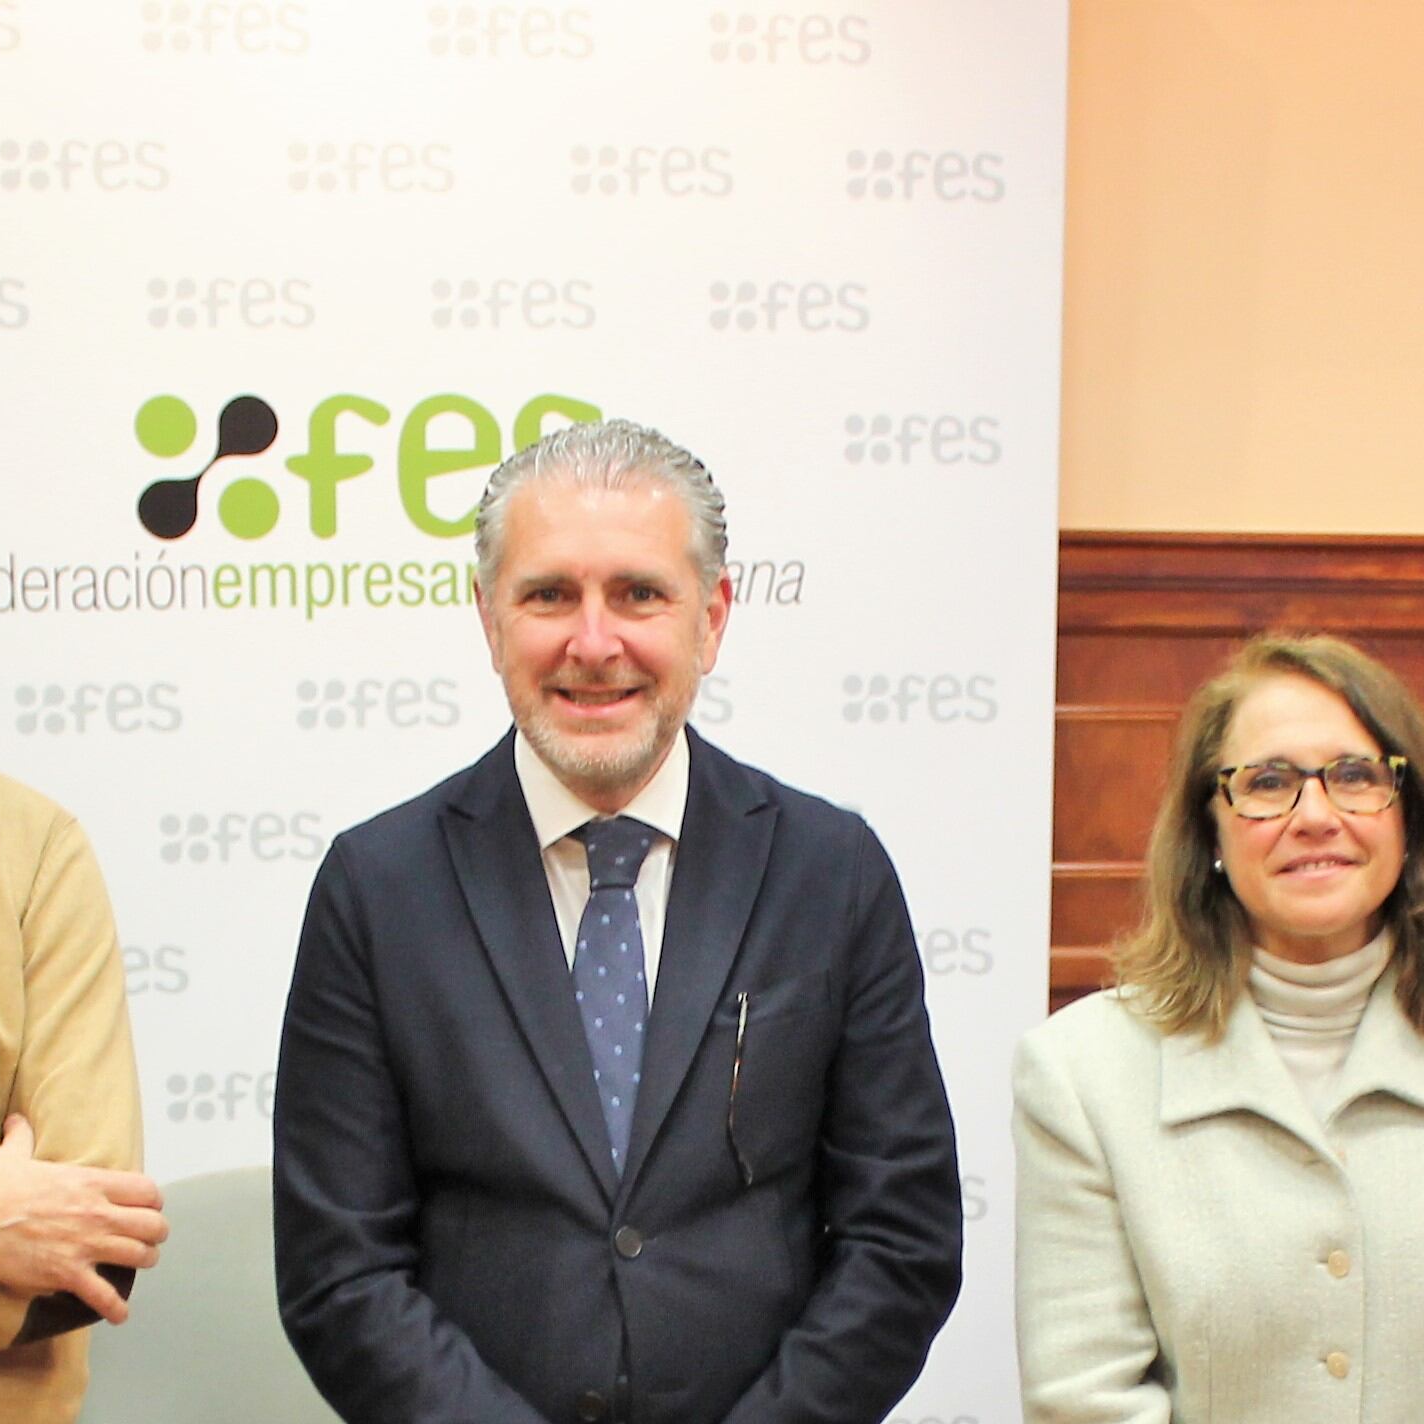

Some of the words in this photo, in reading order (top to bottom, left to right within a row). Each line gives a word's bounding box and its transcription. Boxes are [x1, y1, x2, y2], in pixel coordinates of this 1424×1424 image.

[192, 1, 311, 56] fes
[480, 5, 596, 61] fes
[761, 13, 872, 67] fes
[53, 138, 171, 192] fes
[340, 141, 456, 194] fes
[622, 145, 734, 198] fes
[896, 150, 1006, 204] fes
[201, 277, 316, 330] fes
[483, 278, 597, 330] fes
[759, 280, 871, 333] fes
[894, 414, 1003, 466] fes
[68, 681, 183, 734] fes
[347, 677, 461, 729] fes
[890, 673, 999, 724] fes
[211, 811, 325, 863] fes
[124, 944, 190, 995] es
[917, 927, 995, 976] es
